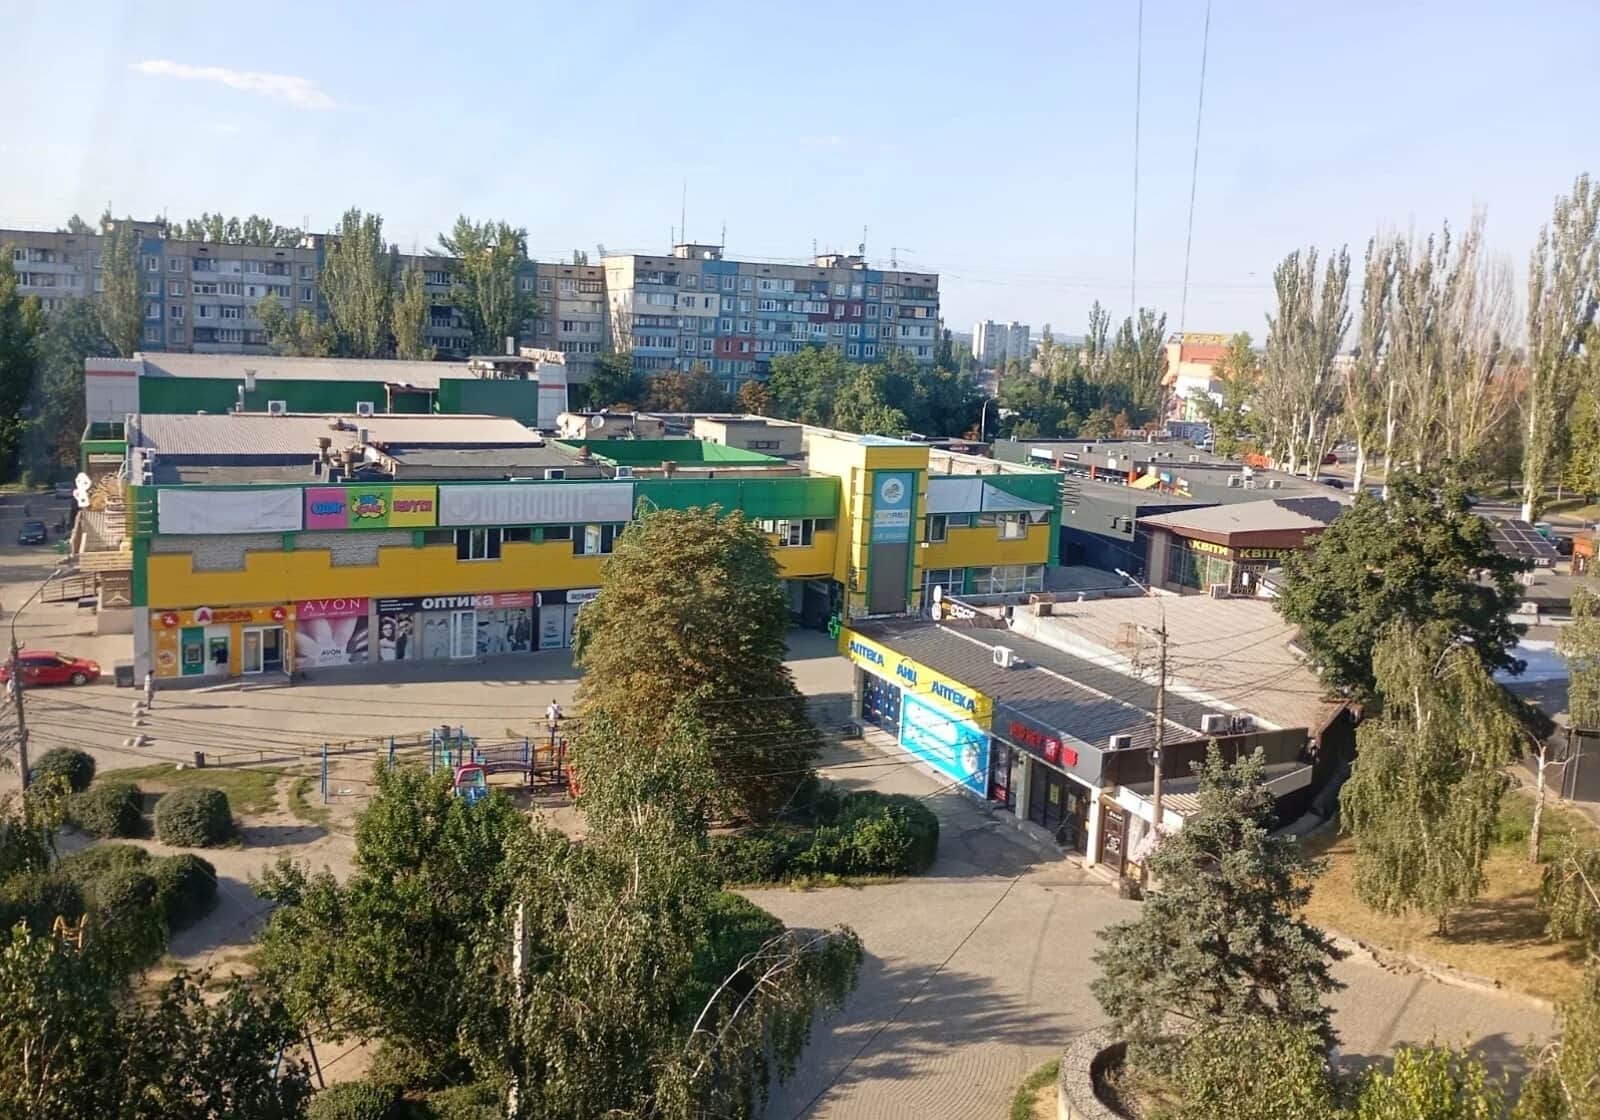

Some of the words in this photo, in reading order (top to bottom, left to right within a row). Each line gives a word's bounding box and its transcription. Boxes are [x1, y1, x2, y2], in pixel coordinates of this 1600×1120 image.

[1192, 540, 1228, 556] КВІТИ
[304, 599, 360, 612] AVON
[849, 640, 884, 667] АПТЕКА
[896, 663, 917, 686] АНЦ
[931, 680, 976, 713] АПТЕКА
